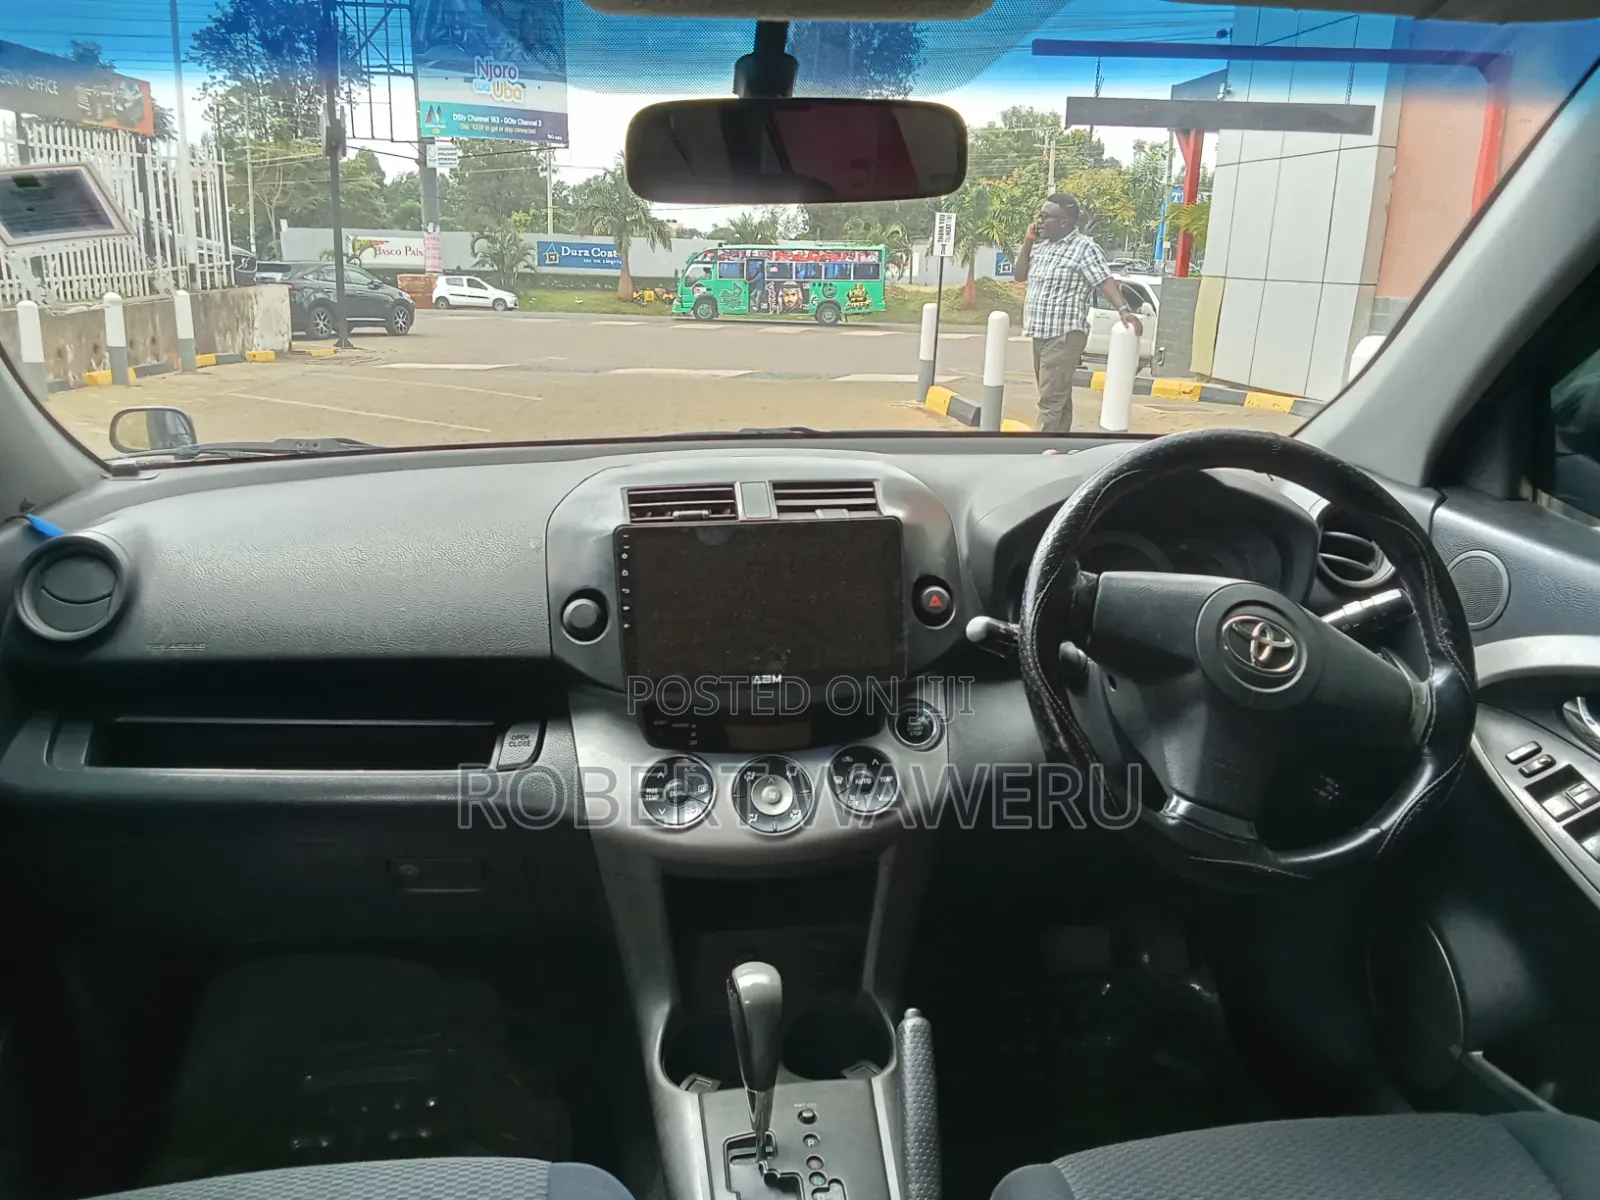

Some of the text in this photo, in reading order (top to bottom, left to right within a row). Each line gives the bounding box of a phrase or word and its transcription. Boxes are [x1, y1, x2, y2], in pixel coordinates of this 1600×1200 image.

[476, 58, 519, 81] Njoro
[27, 74, 59, 95] OFFICE
[492, 80, 523, 101] Uba
[468, 114, 490, 124] Channel
[490, 115, 500, 124] 163
[517, 118, 538, 127] Channel
[561, 246, 618, 258] Dura Coat
[508, 740, 532, 748] CLOSE
